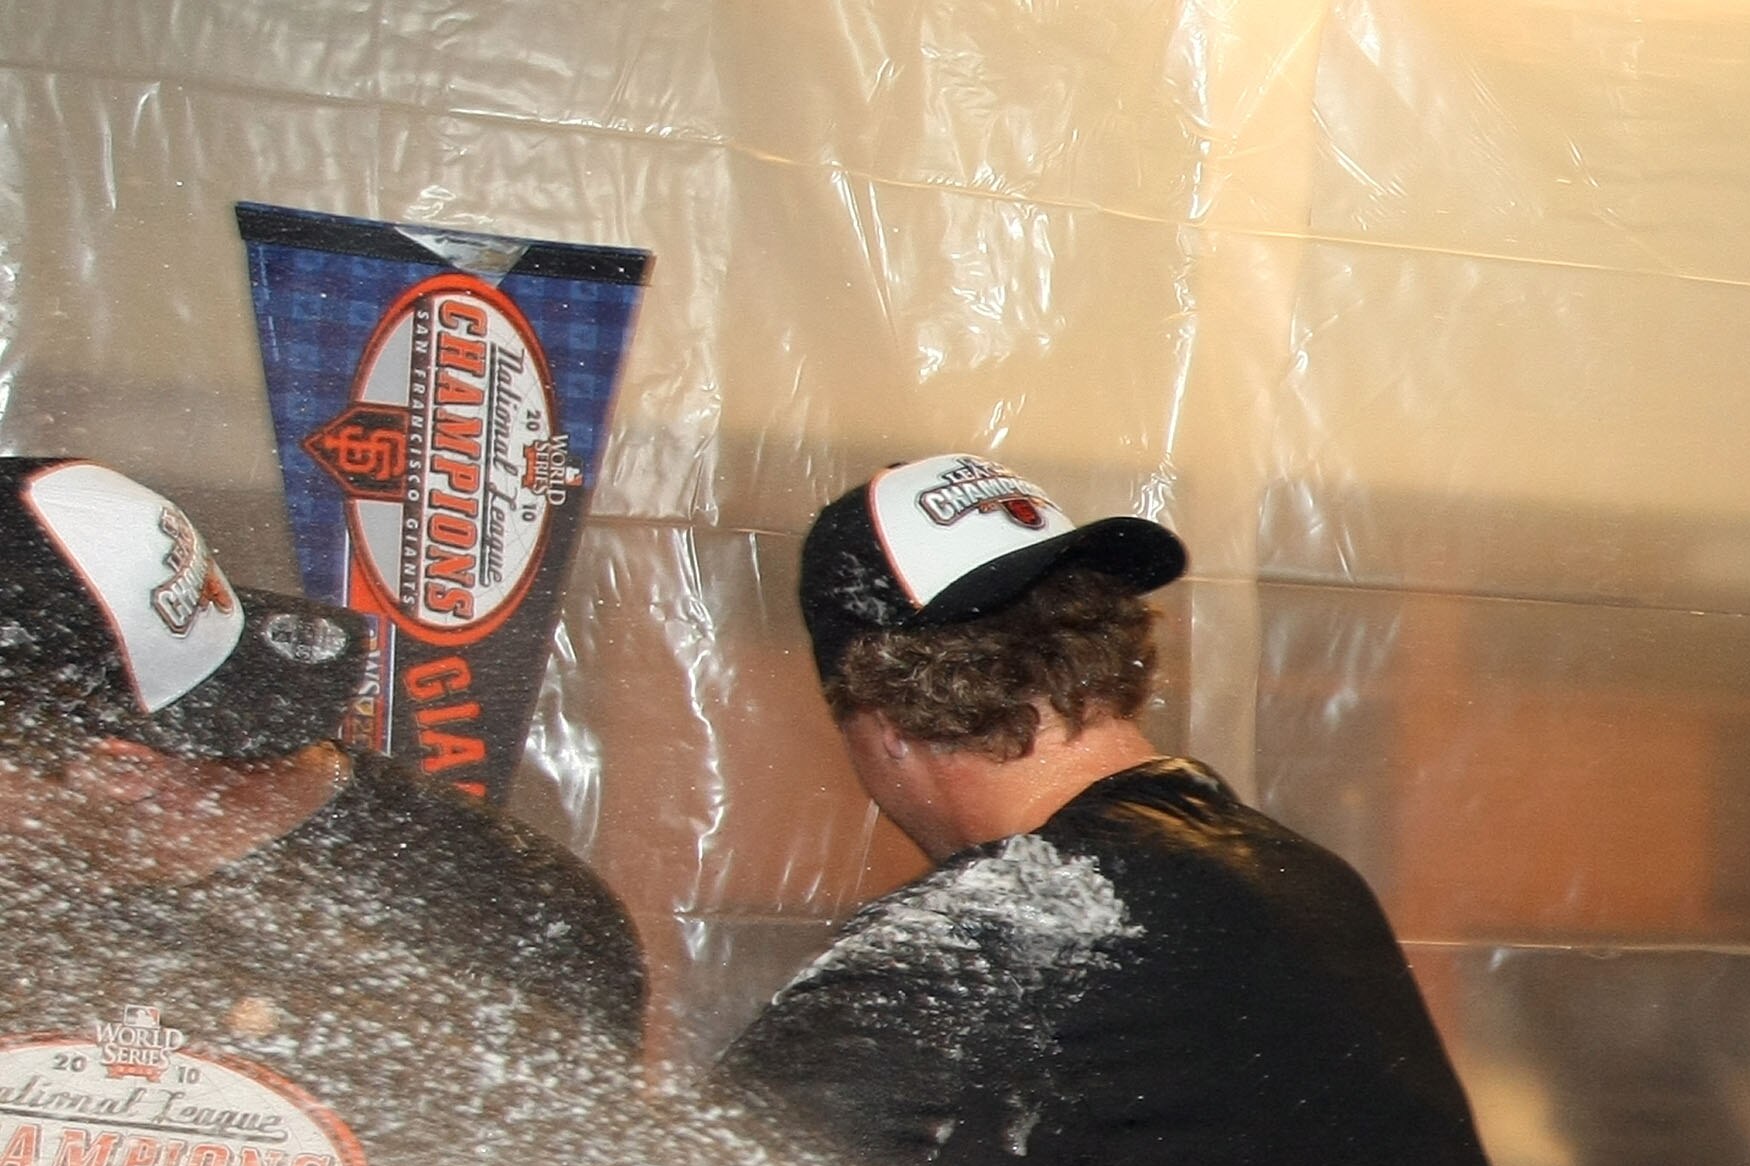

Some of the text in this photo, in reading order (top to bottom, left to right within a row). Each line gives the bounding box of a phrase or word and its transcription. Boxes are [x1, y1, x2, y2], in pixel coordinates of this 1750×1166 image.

[402, 310, 430, 605] SAN FRANCISCO GIANTS
[424, 300, 489, 619] CHAMPIONS
[488, 345, 525, 583] National League
[522, 410, 541, 522] 20 10
[532, 441, 551, 495] SERIES
[548, 434, 569, 505] WORLD
[53, 1054, 87, 1073] 20
[176, 1065, 201, 1085] 10
[96, 1023, 184, 1051] WORLD
[102, 1044, 170, 1070] SERIES
